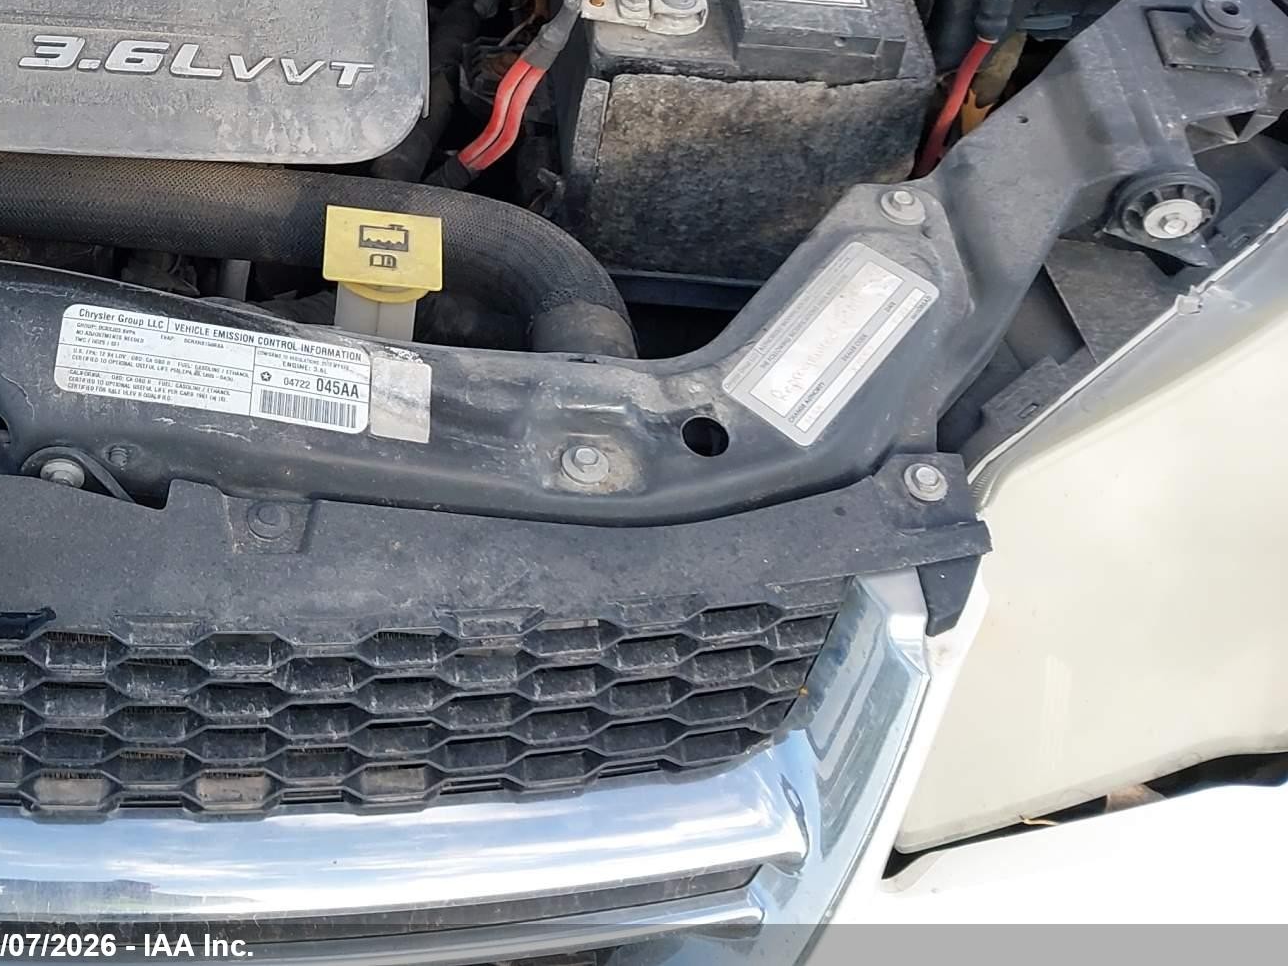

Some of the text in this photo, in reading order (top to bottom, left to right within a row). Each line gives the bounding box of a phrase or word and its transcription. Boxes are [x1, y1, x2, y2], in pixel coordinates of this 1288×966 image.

[79, 307, 115, 322] Chrysler
[117, 313, 144, 326] Group
[147, 318, 163, 329] LLC
[174, 322, 210, 336] VEHICLE
[212, 328, 254, 343] EMISSION
[257, 336, 297, 350] CONTROL
[301, 343, 361, 361] INFORMATION
[282, 361, 310, 371] ENGINE:
[283, 376, 359, 398] 04722 045AA
